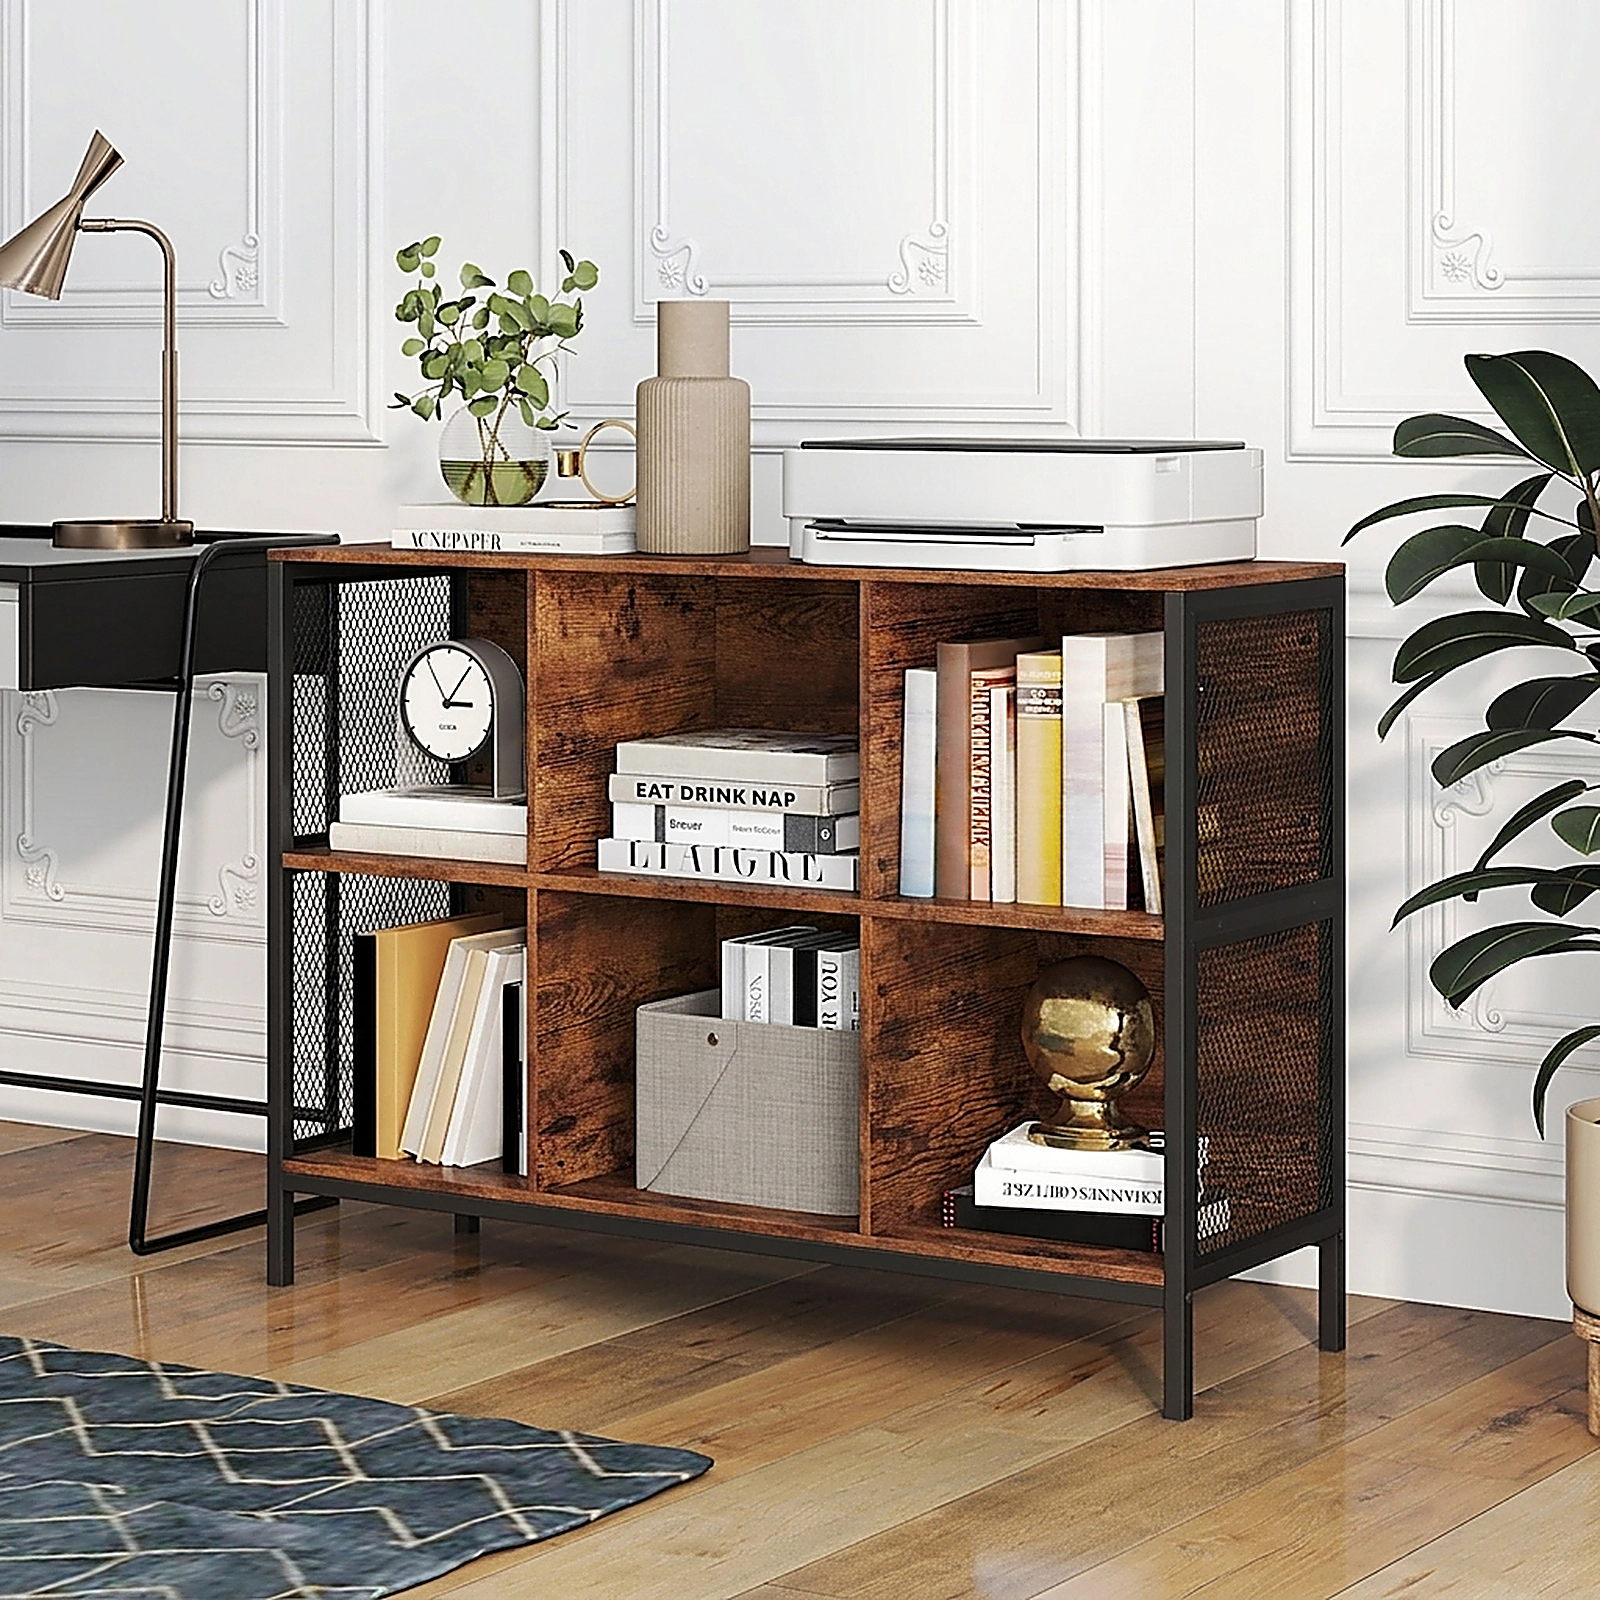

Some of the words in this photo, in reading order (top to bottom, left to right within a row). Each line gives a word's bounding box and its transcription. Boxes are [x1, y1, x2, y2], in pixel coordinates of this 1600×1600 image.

[636, 782, 675, 799] EAT
[680, 785, 746, 805] DRINK
[752, 790, 796, 808] NAP
[821, 960, 838, 1003] YOU
